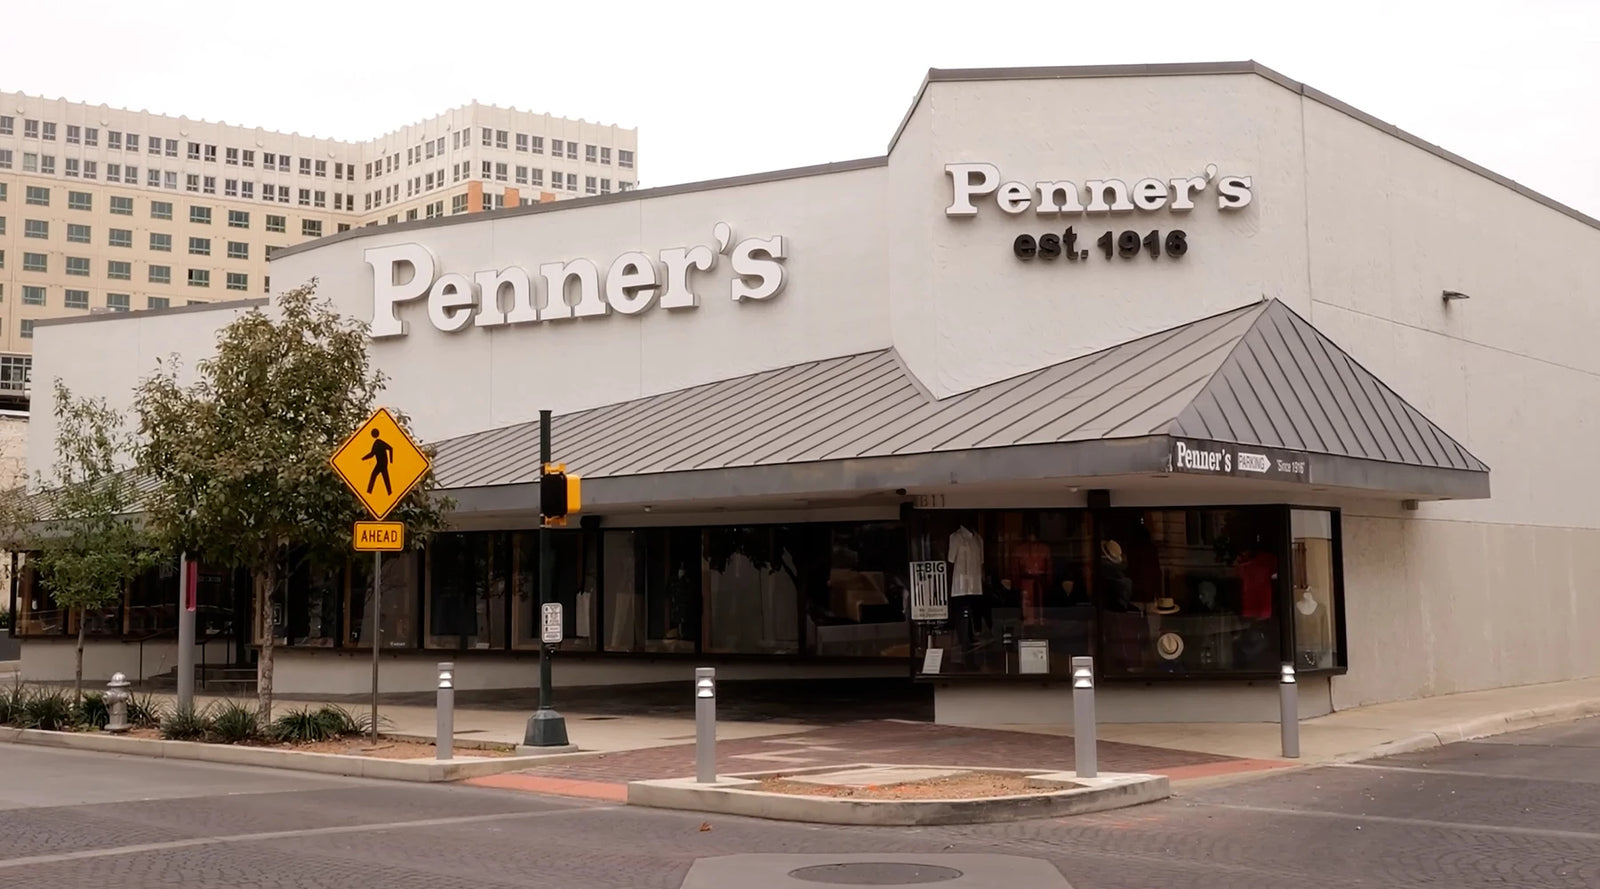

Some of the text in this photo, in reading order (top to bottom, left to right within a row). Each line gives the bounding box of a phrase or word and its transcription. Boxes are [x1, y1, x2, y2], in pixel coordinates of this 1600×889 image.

[944, 163, 1253, 218] Penner's
[1013, 226, 1189, 261] est. 1916
[363, 221, 788, 339] Penner's
[1176, 441, 1232, 472] Penner's
[1239, 454, 1265, 471] PARKING
[361, 529, 399, 544] AHEAD
[925, 562, 945, 573] BIG
